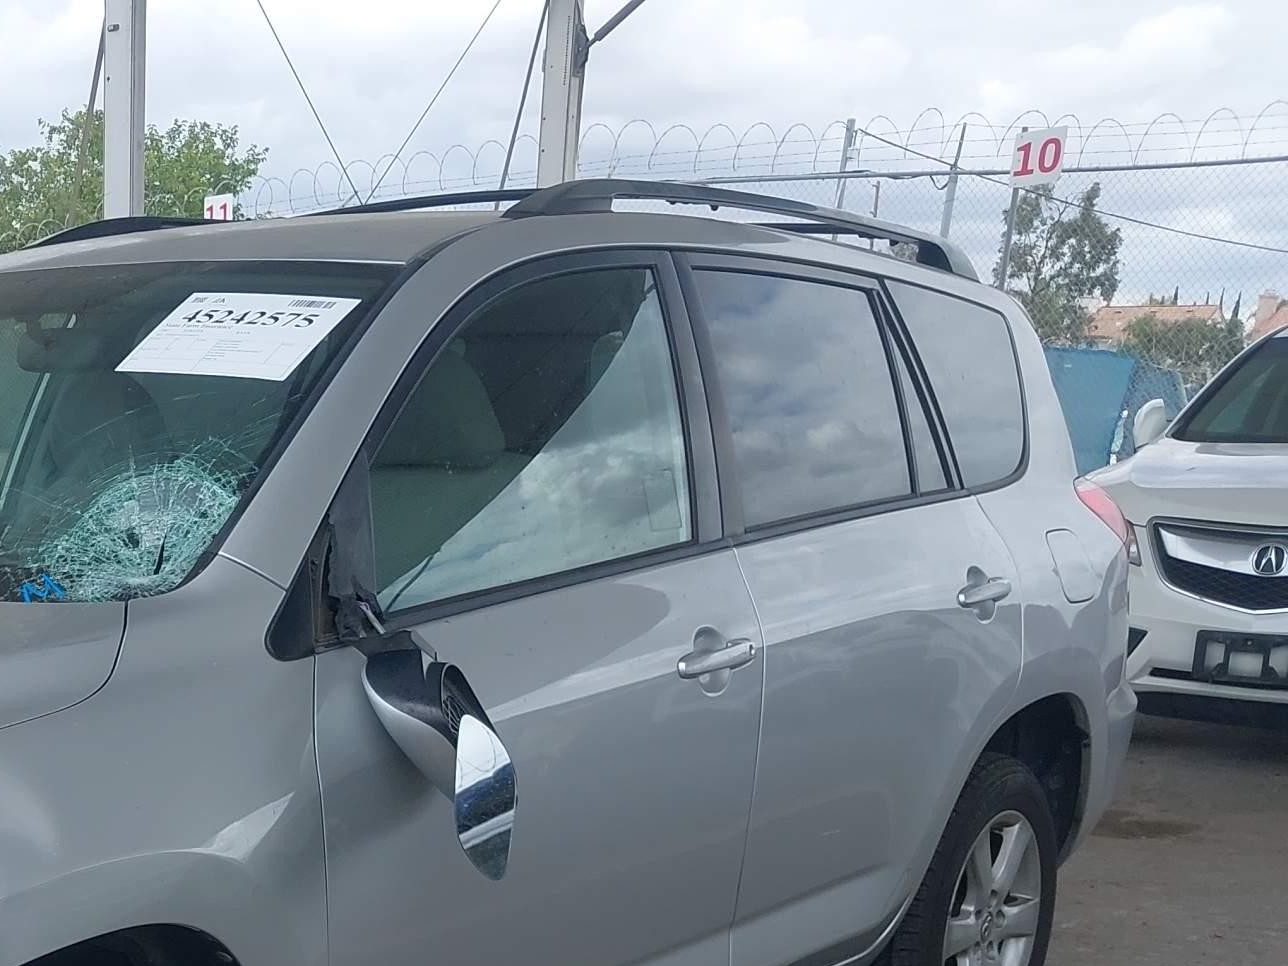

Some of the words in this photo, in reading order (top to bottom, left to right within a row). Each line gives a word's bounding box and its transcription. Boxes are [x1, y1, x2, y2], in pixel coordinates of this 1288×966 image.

[1013, 137, 1062, 177] 10
[206, 202, 227, 220] 11
[181, 309, 321, 329] 45242575
